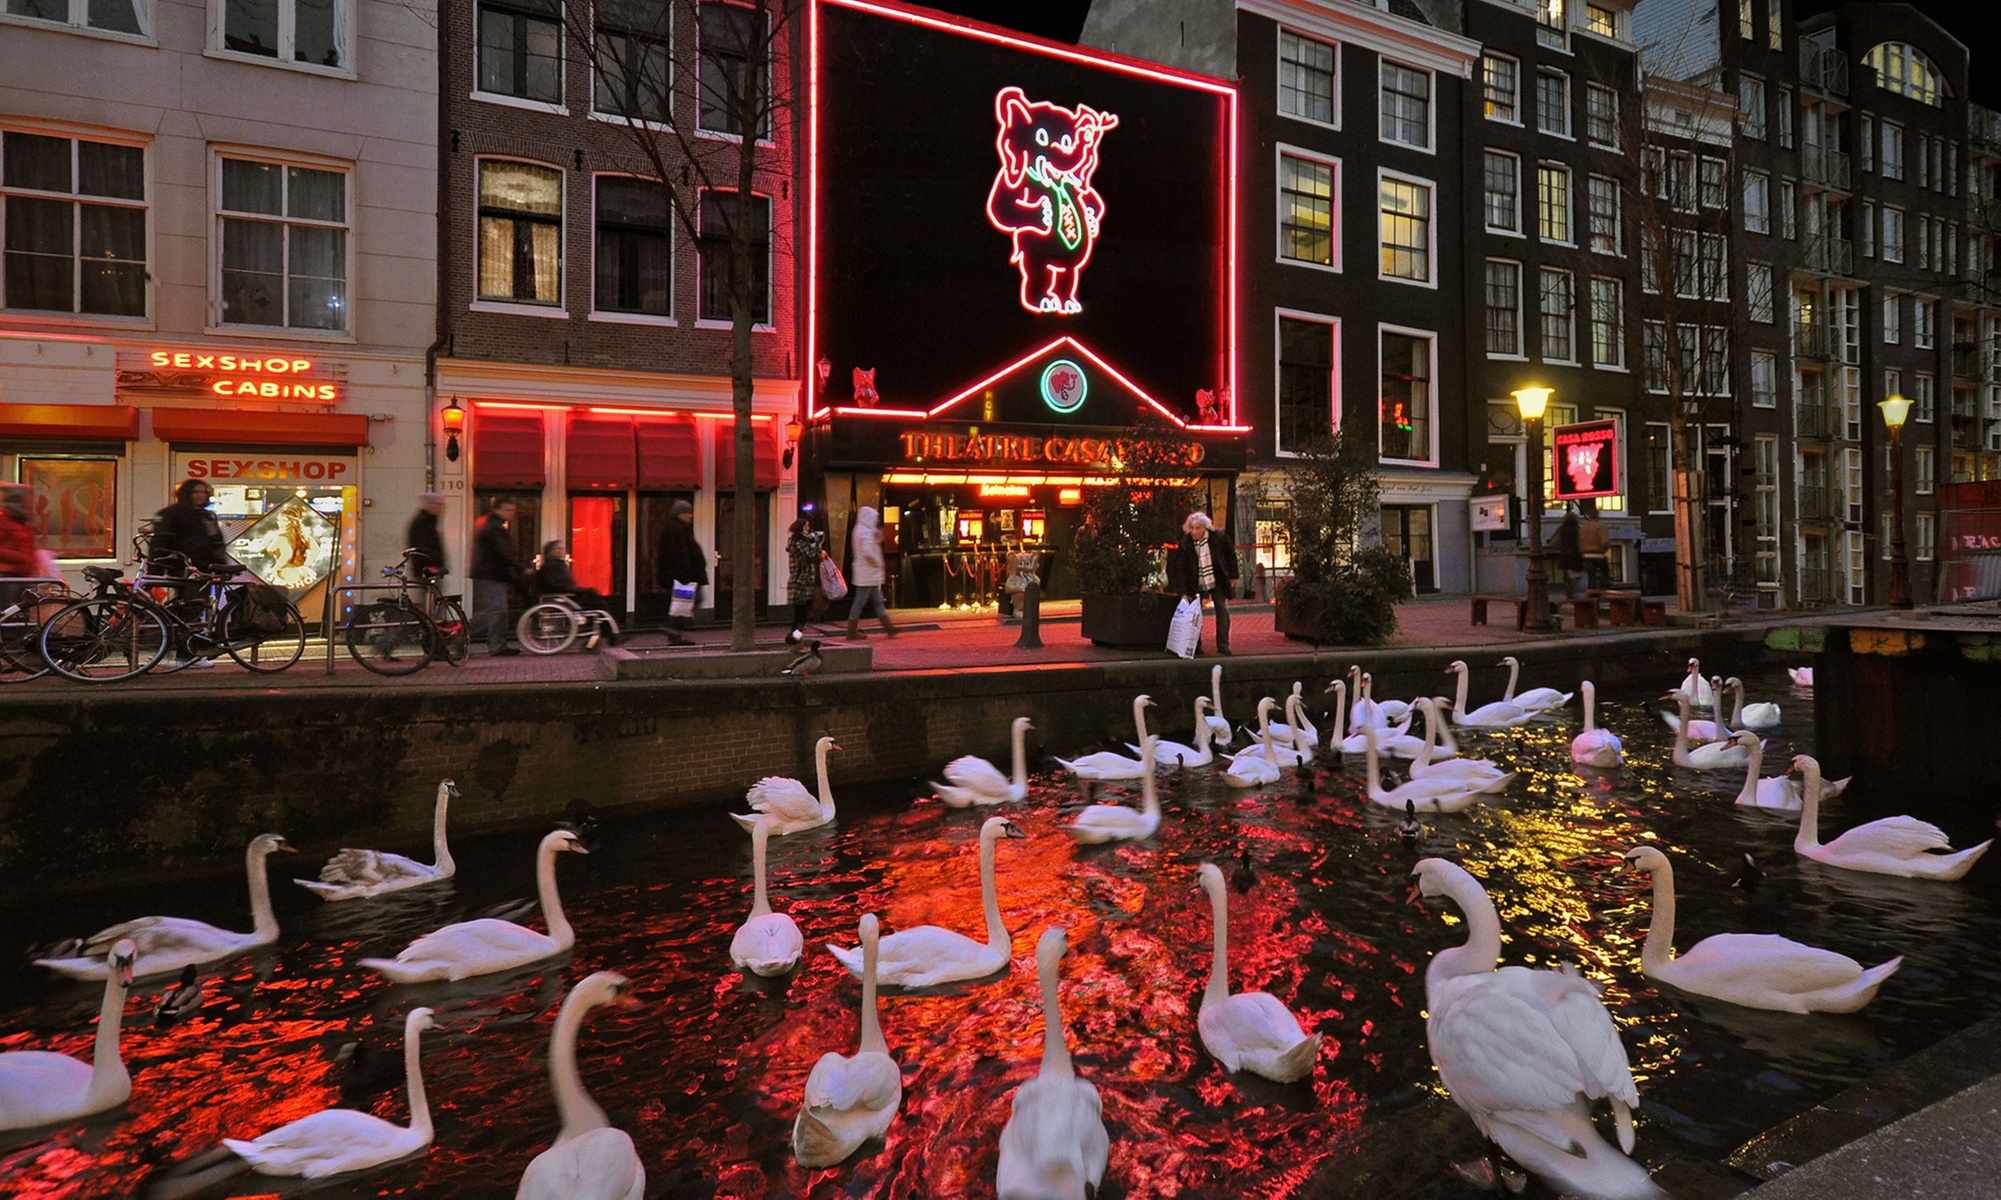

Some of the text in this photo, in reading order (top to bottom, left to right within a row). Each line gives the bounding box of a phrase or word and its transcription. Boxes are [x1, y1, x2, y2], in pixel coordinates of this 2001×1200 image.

[151, 352, 311, 373] SEXSHOP
[213, 381, 336, 400] CABINS
[1557, 429, 1614, 445] CASA ROSSO
[900, 433, 1043, 461] THEATRE
[187, 459, 346, 480] SEXSHOP
[440, 480, 464, 490] 110
[981, 484, 1028, 496] Heineken
